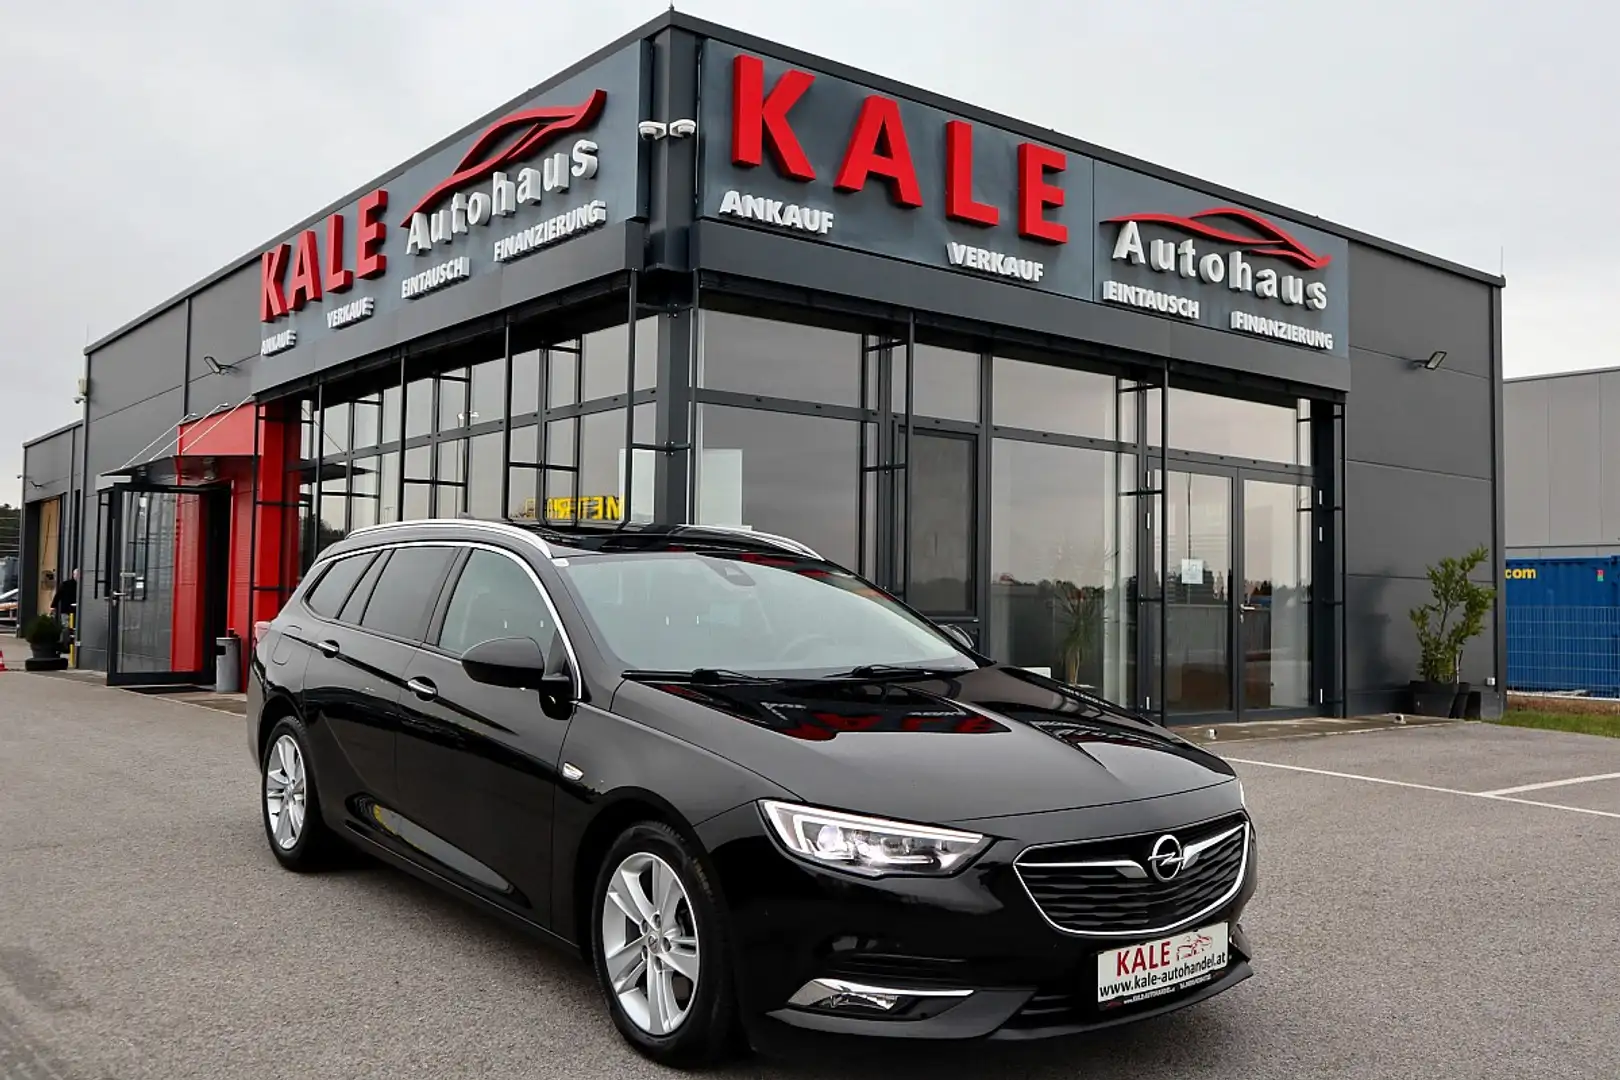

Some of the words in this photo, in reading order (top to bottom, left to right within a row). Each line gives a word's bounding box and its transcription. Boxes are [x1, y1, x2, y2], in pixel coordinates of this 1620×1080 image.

[261, 189, 388, 323] KALE
[406, 139, 598, 255] Autohaus
[731, 54, 1068, 245] KALE
[1112, 220, 1327, 310] Autohaus
[327, 296, 374, 328] VERKAUF
[401, 256, 470, 300] EINTAUSCH
[494, 200, 606, 262] FINANZIERUNG
[719, 190, 834, 235] ANKAUF
[946, 241, 1044, 282] VERKAUF
[1103, 280, 1199, 319] EINTAUSCH
[1230, 310, 1334, 350] FINANZIERUNG
[1099, 952, 1226, 997] www.kale-autohandel.at
[1116, 941, 1171, 977] KALE
